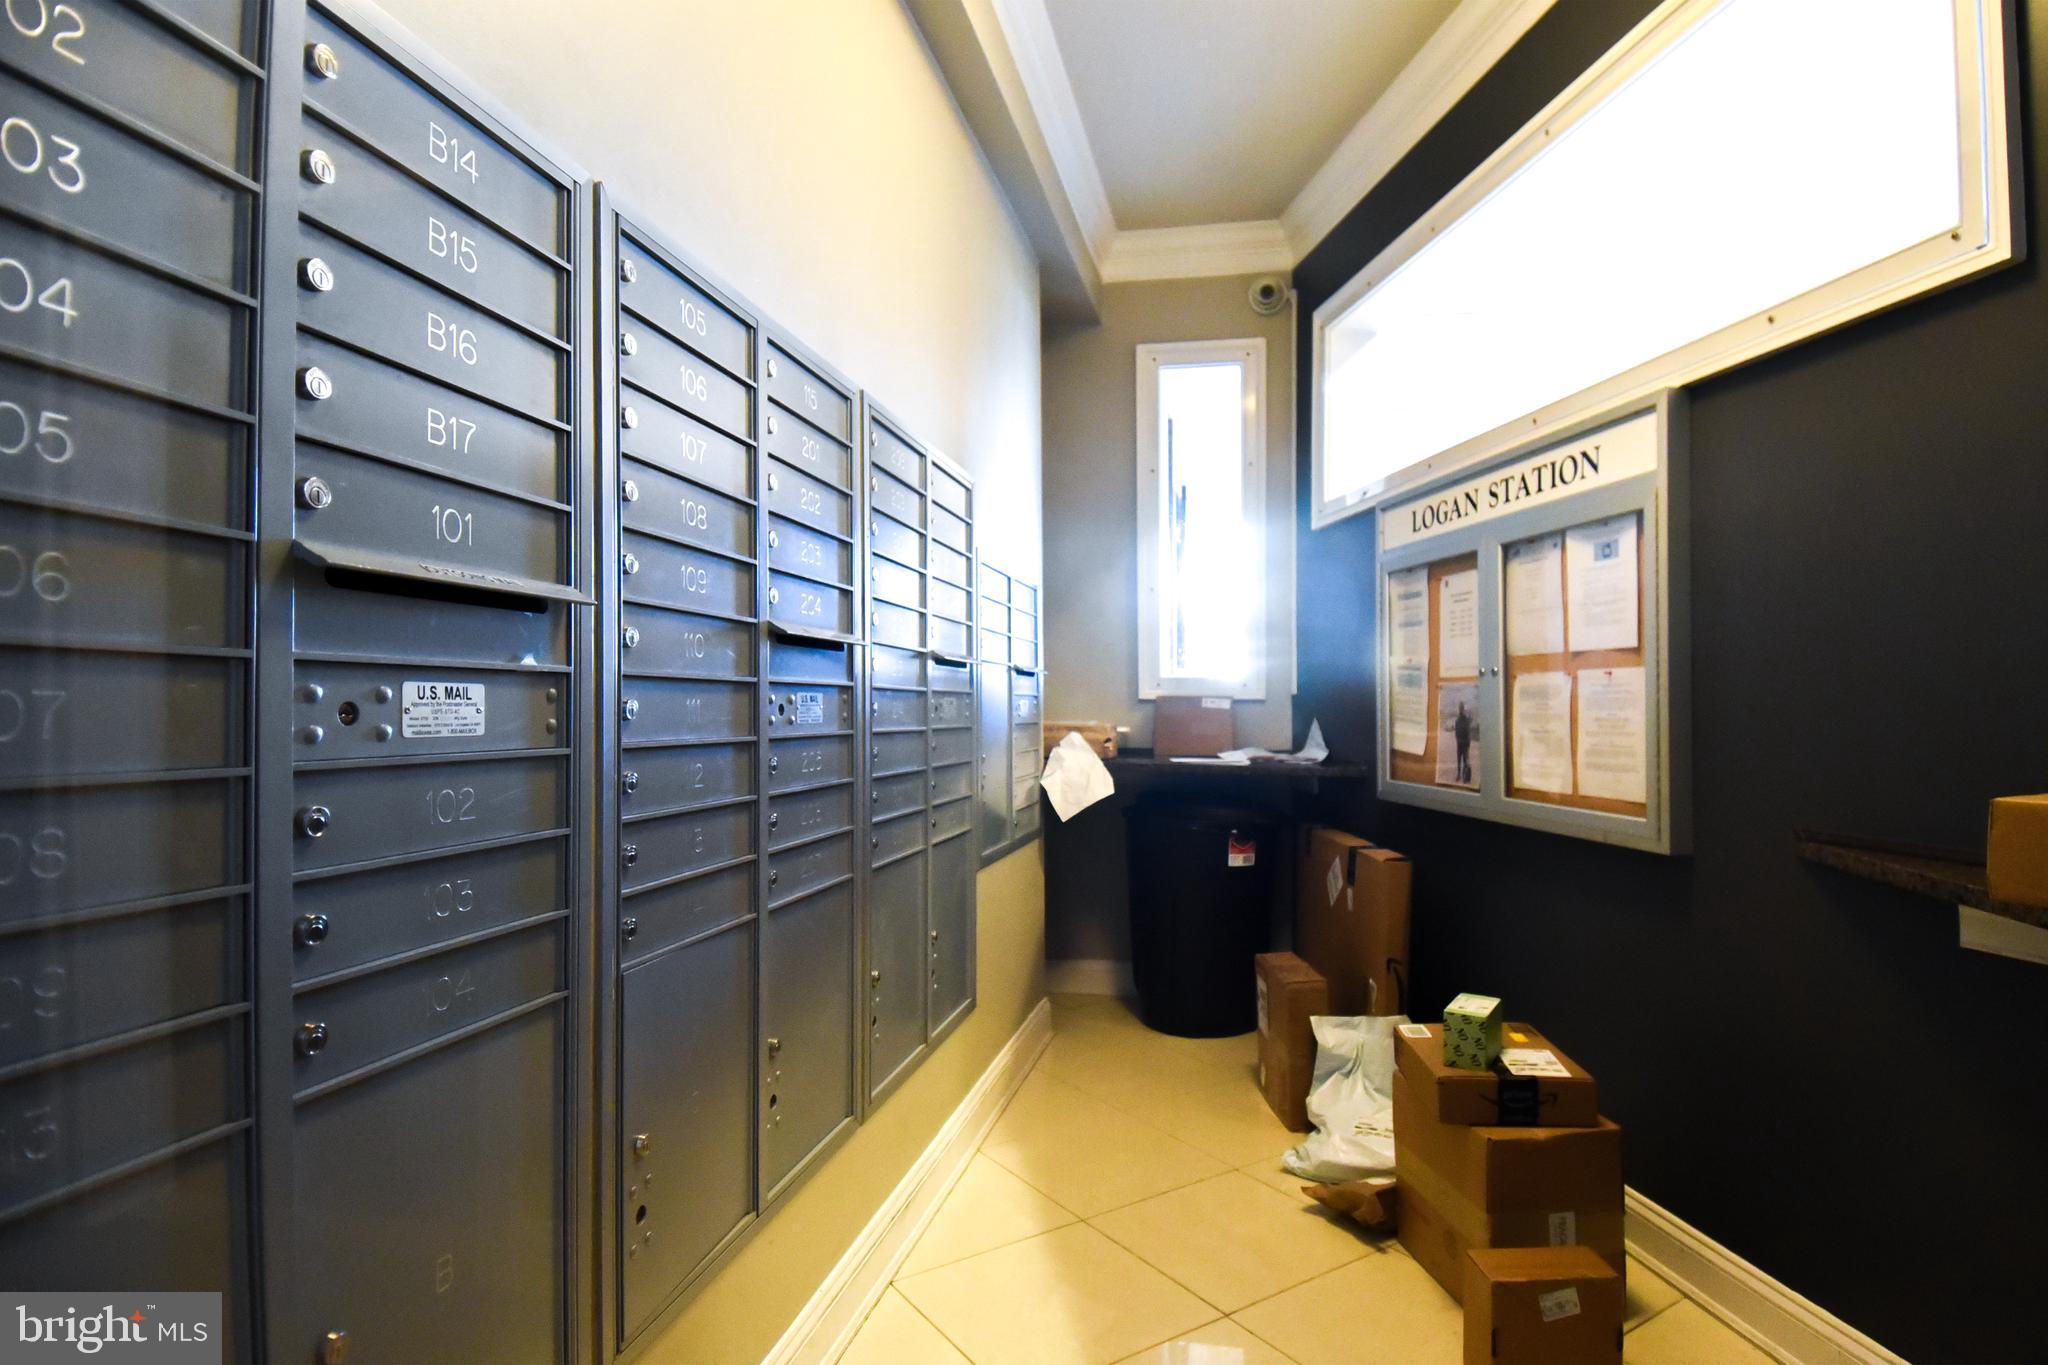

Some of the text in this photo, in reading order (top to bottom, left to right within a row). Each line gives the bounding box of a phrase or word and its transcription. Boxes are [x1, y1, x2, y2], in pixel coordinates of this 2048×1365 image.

[1, 118, 84, 192] 03
[429, 121, 479, 184] B14
[428, 216, 478, 274] B15
[0, 258, 78, 328] 04
[680, 298, 706, 336] 105
[427, 311, 478, 366] B16
[680, 365, 707, 402] 106
[803, 384, 818, 410] 115
[0, 402, 73, 463] 05
[426, 407, 477, 454] B17
[680, 432, 707, 464] 107
[801, 436, 819, 462] 201
[800, 487, 822, 516] 202
[1411, 444, 1601, 533] LOGAN STATION
[432, 505, 473, 547] 101
[680, 498, 707, 530] 108
[0, 546, 70, 601] 06
[680, 564, 707, 594] 109
[417, 685, 472, 701] U.S. MAIL
[426, 787, 476, 824] 102
